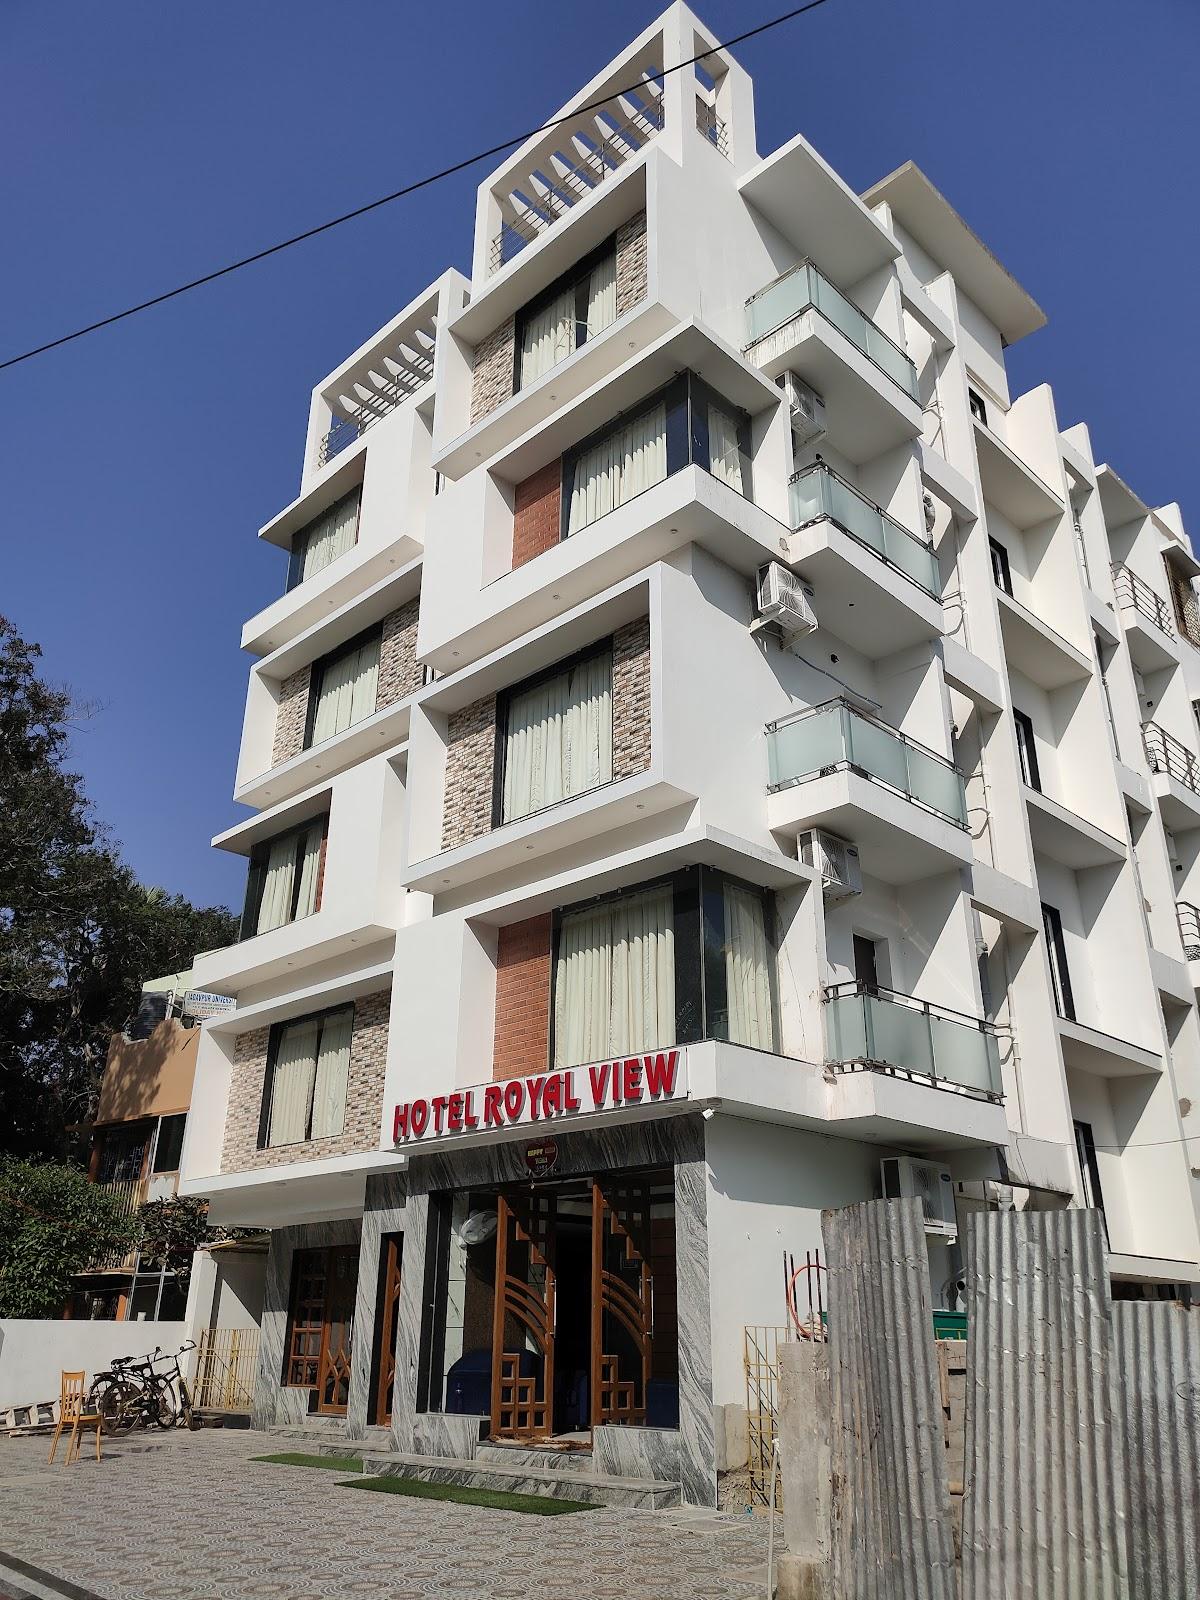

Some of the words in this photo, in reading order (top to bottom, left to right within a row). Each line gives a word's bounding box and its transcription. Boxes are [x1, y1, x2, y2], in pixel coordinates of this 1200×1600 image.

[392, 1091, 479, 1145] HOTEL
[484, 1071, 582, 1127] ROYAL
[588, 1050, 680, 1109] VIEW
